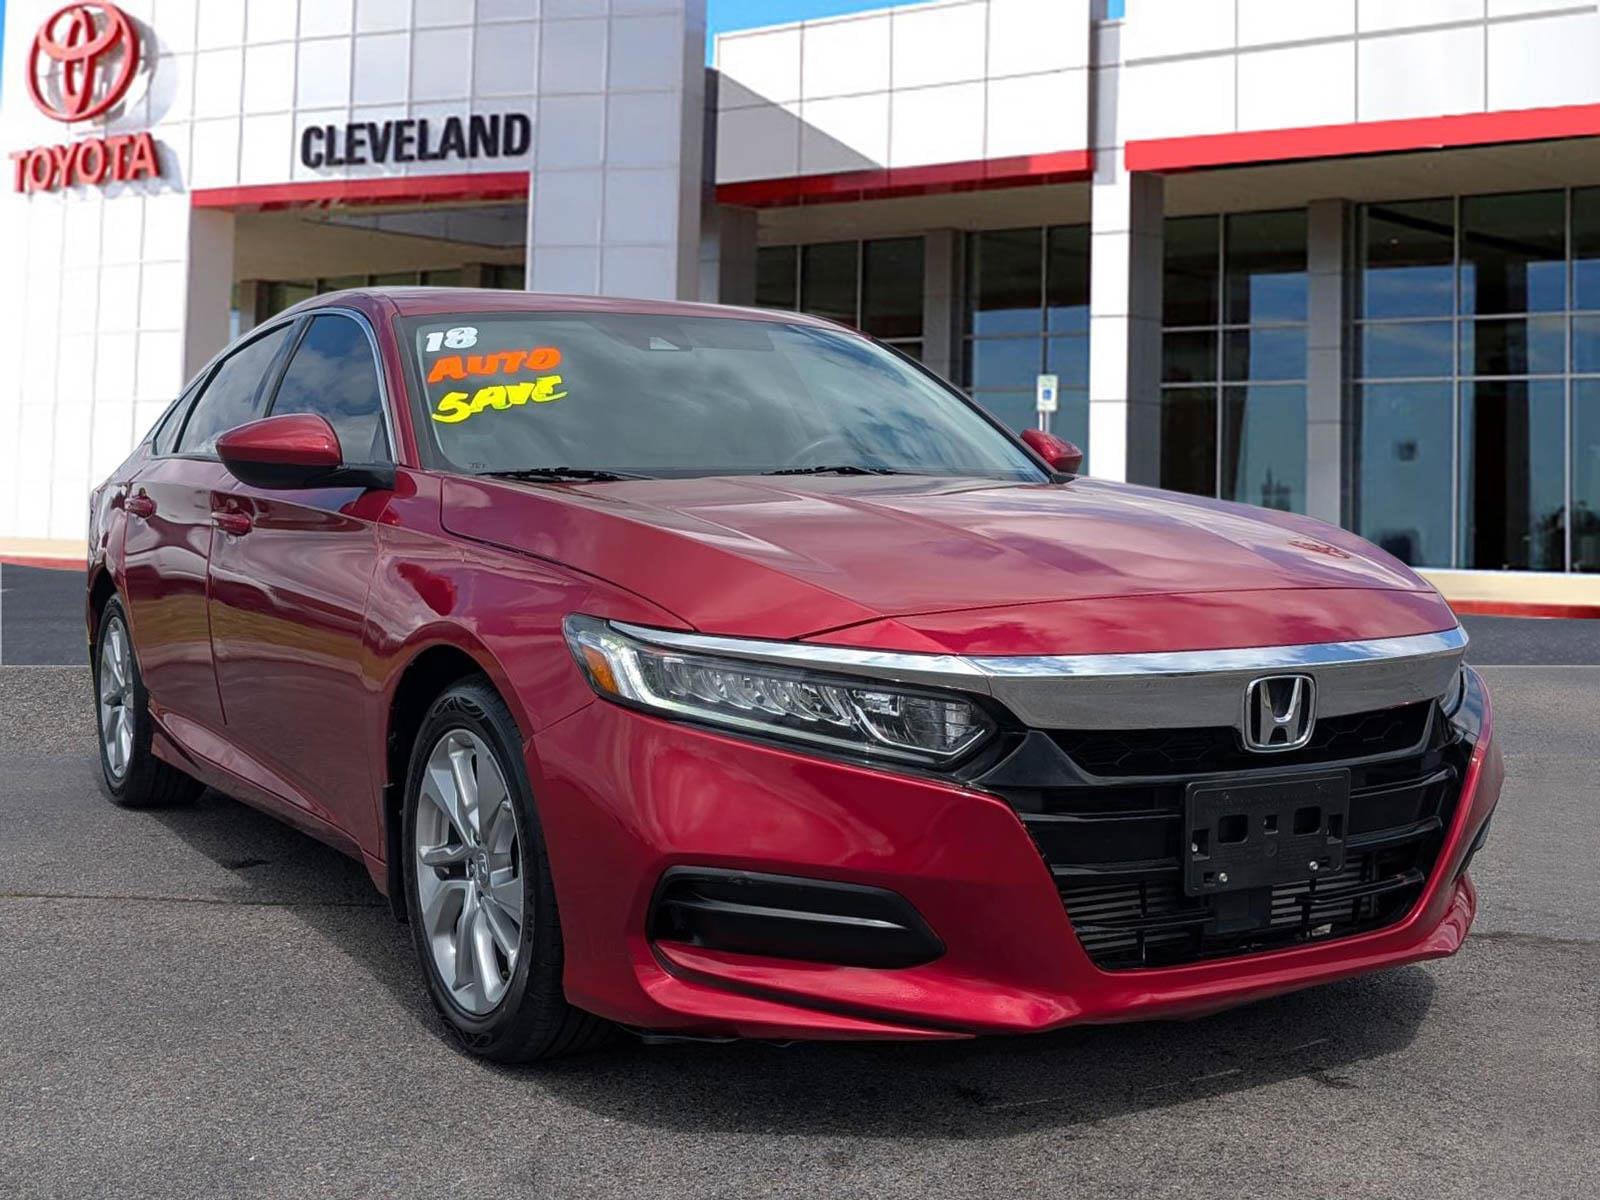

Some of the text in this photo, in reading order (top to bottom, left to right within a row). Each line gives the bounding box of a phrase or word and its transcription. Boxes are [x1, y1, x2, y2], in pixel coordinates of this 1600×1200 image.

[9, 132, 161, 194] TOYOTA
[301, 113, 531, 169] CLEVELAND
[426, 326, 479, 352] 18
[427, 346, 562, 384] AUTO
[432, 375, 568, 423] SAVE
